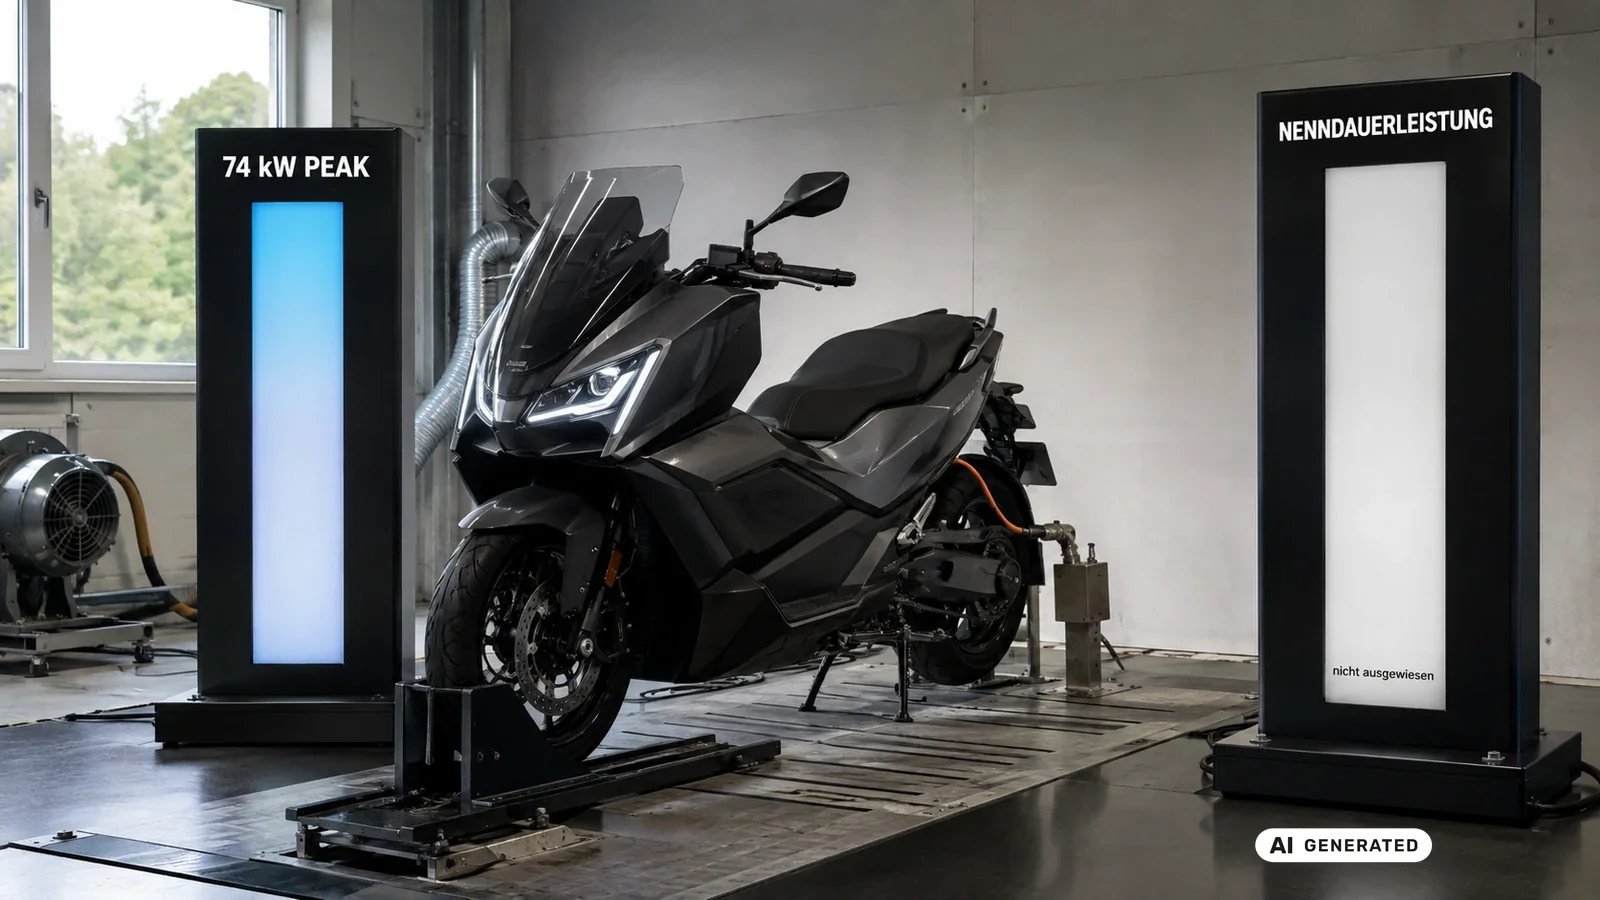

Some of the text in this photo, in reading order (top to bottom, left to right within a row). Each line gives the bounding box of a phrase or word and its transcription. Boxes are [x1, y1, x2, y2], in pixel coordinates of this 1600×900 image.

[1279, 107, 1493, 142] NENNDAUERLEISTUNG
[222, 155, 370, 178] 74 kW PEAK
[1332, 665, 1435, 682] nicht ausgewiesen
